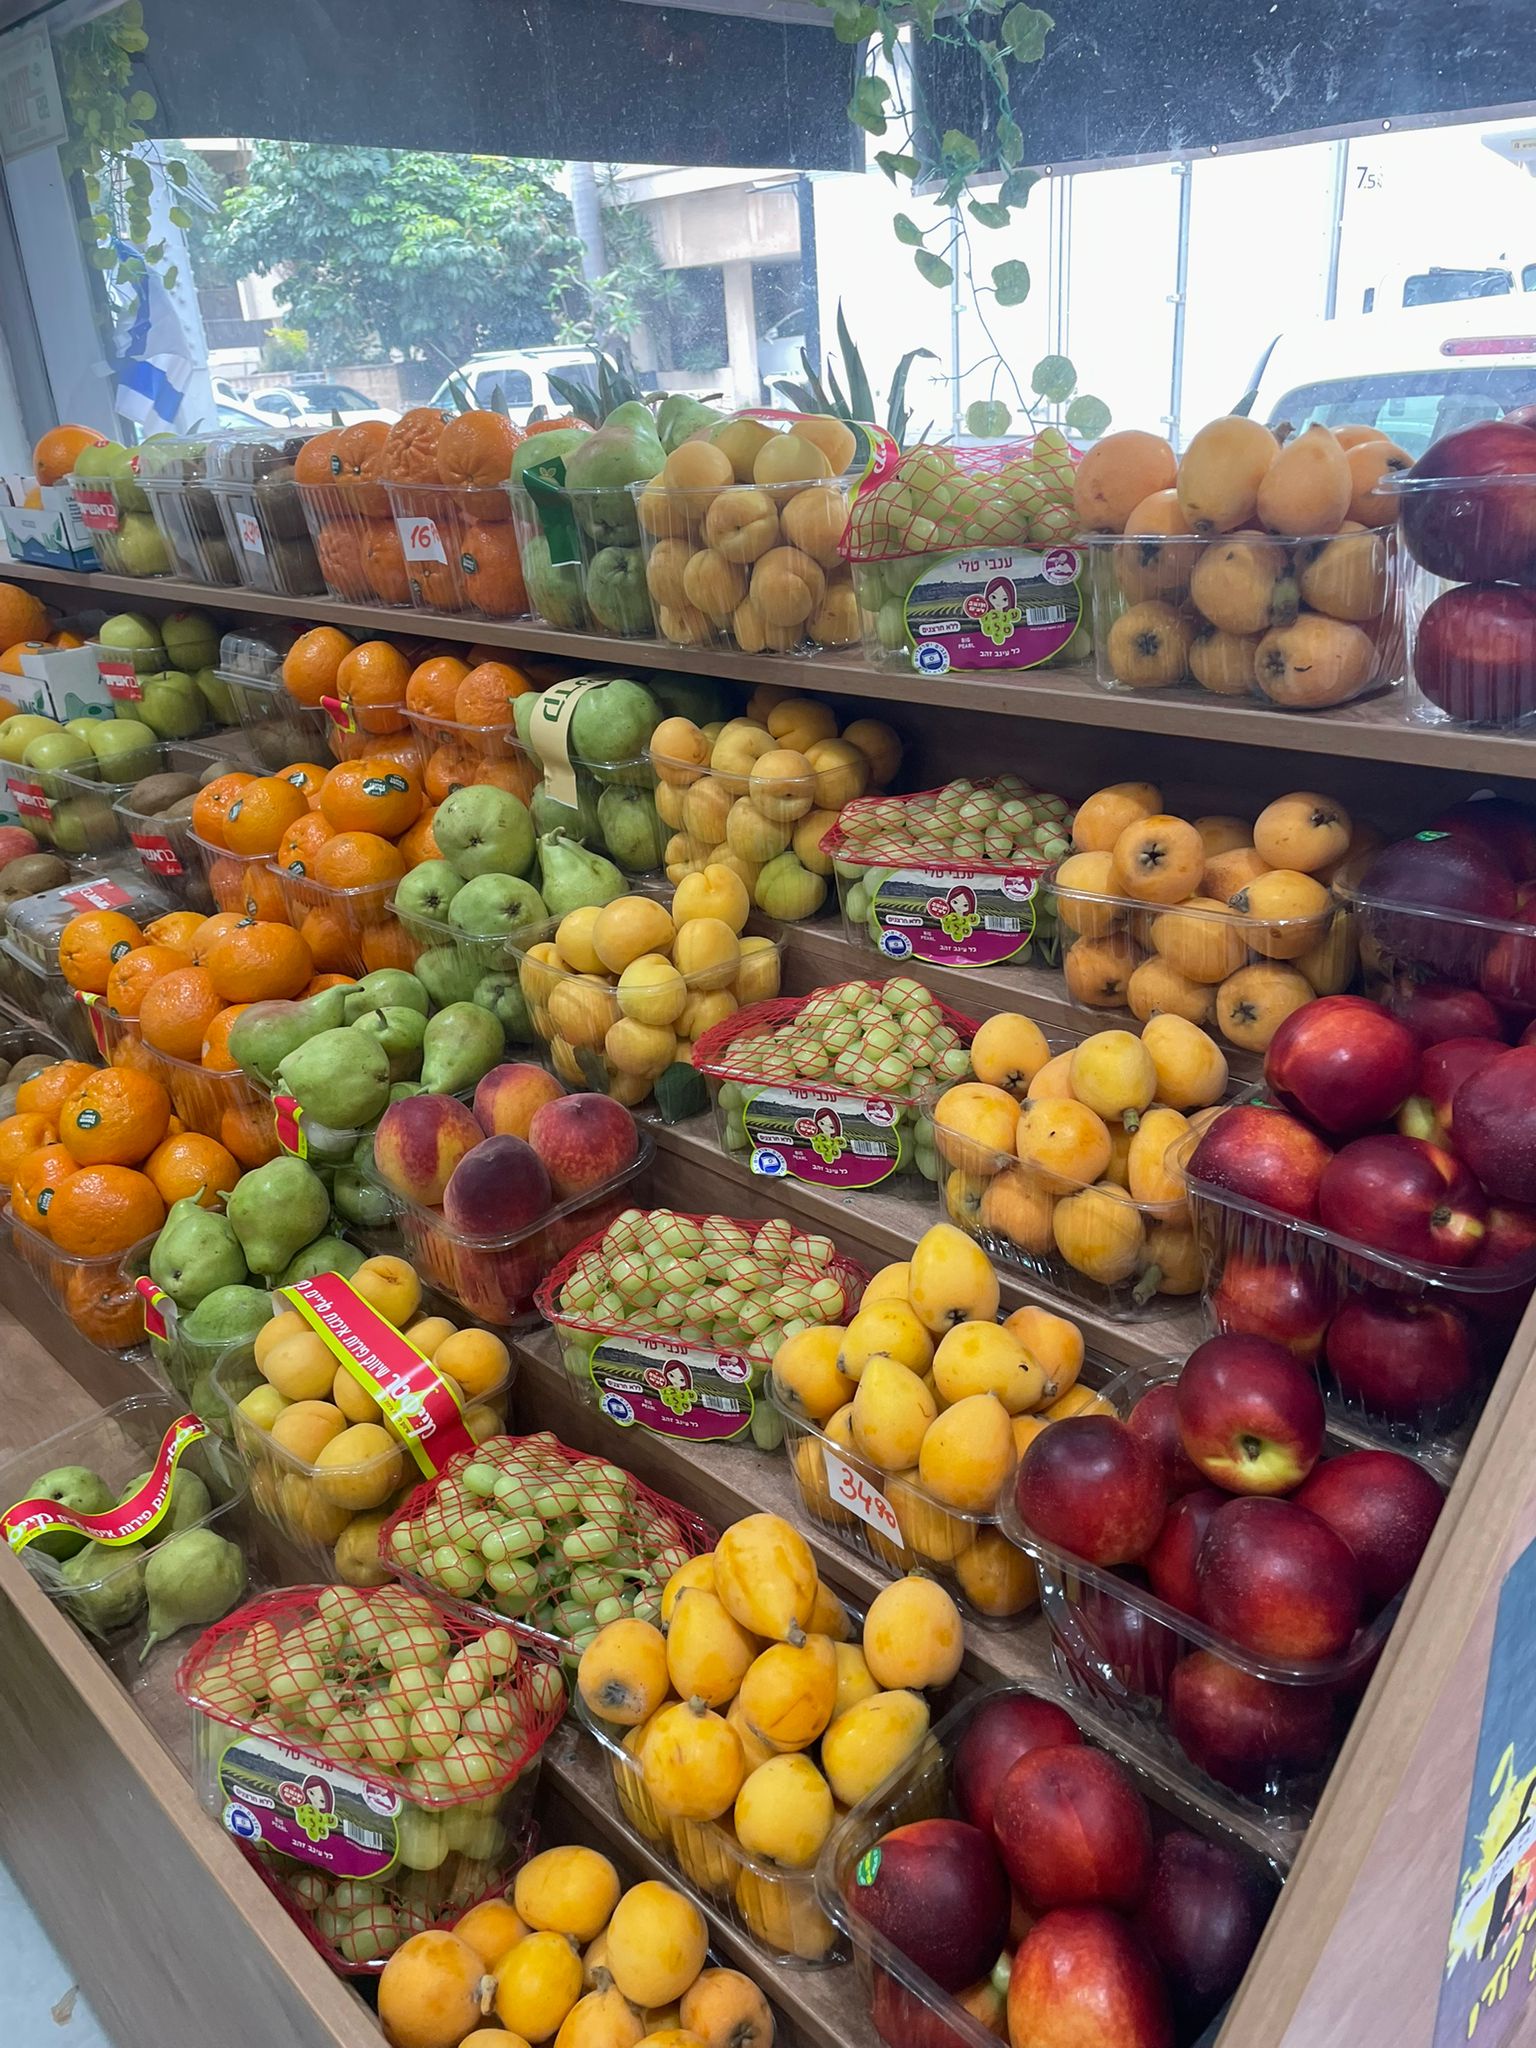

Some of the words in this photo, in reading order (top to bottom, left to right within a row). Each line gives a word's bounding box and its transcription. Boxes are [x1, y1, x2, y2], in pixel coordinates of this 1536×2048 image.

[958, 559, 980, 573] טלי
[984, 556, 1013, 571] ענבי
[945, 622, 959, 632] ללא
[304, 1290, 332, 1313] טריים
[322, 1312, 351, 1338] איכות
[343, 1335, 370, 1357] פירות
[360, 1355, 391, 1379] שיווק
[118, 1509, 153, 1536] פירות
